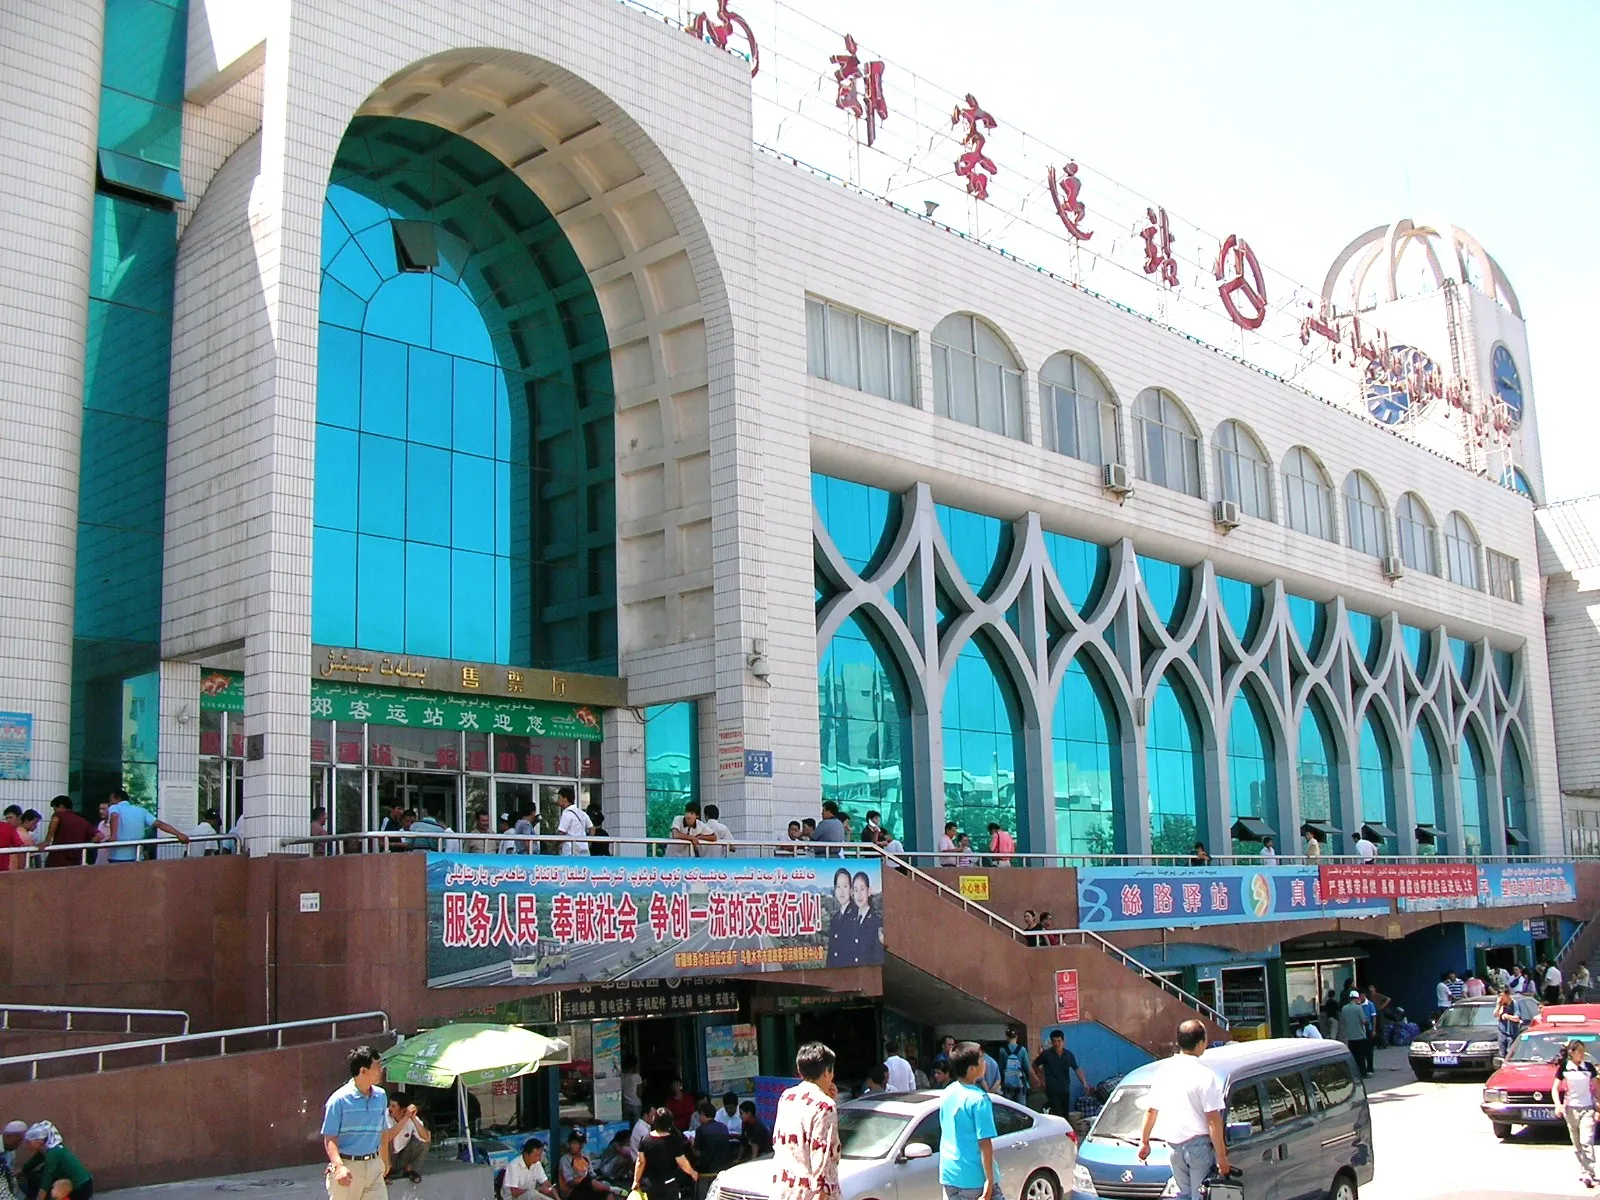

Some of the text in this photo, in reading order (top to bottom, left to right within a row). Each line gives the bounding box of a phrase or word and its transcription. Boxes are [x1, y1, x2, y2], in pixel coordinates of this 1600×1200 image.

[462, 666, 567, 697] 售票厅
[311, 697, 546, 735] 郊客运站欢迎您
[753, 762, 764, 772] 21
[443, 891, 539, 948] 服务人民
[552, 892, 638, 944] 奉献社会
[562, 992, 737, 1017] 手机缴费 售电话卡 手机配件 充电器 电池 充值卡
